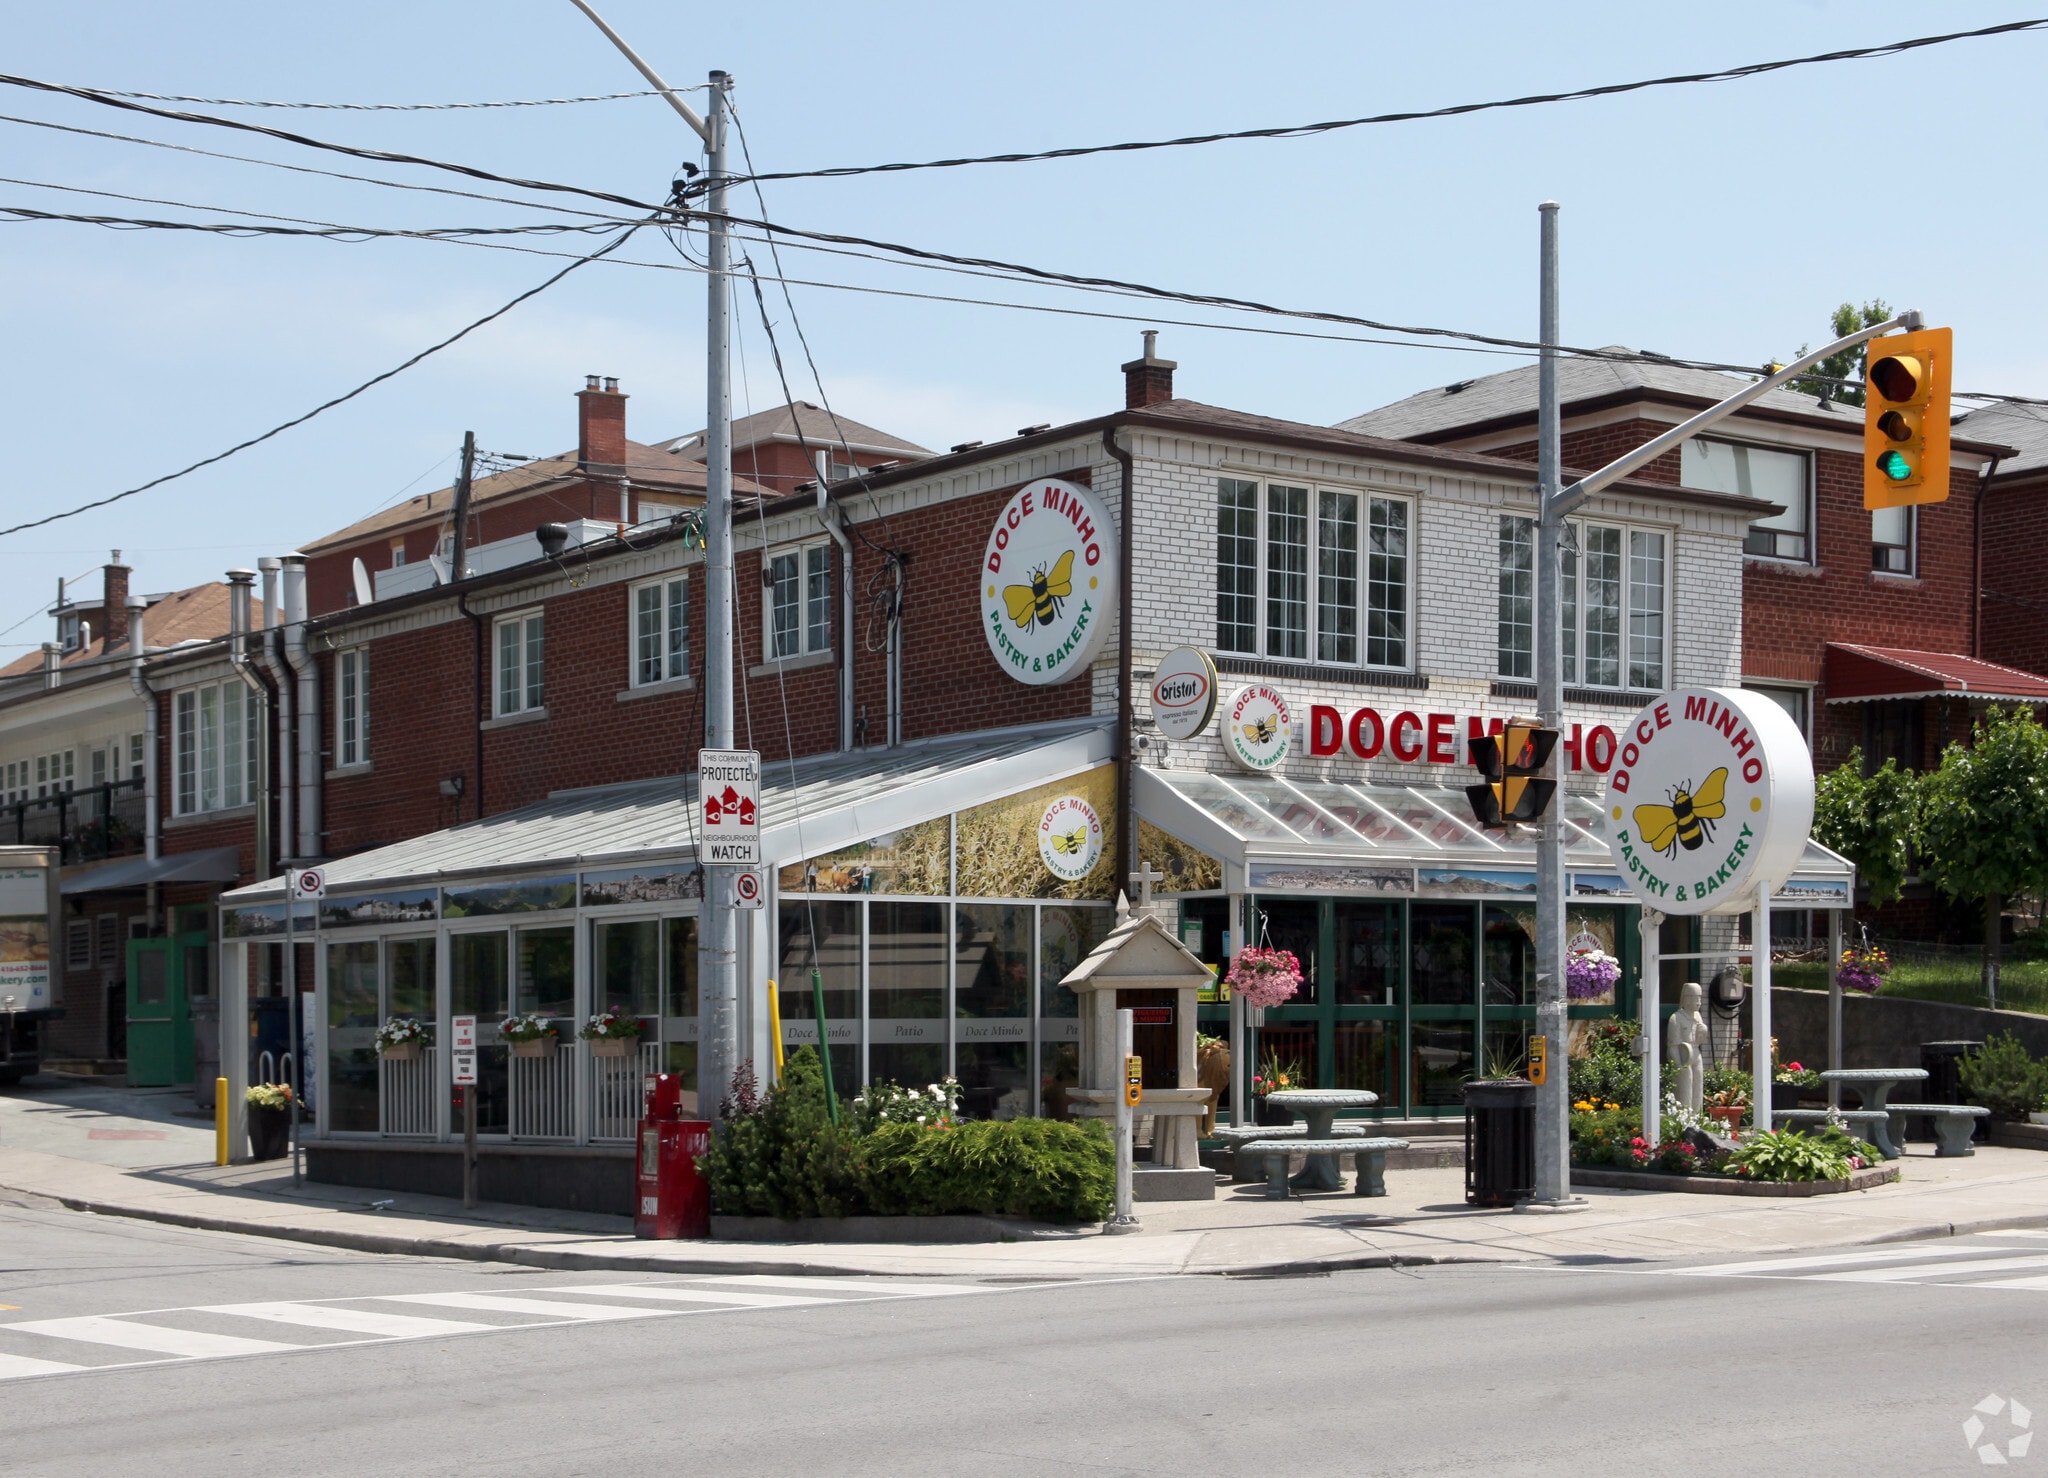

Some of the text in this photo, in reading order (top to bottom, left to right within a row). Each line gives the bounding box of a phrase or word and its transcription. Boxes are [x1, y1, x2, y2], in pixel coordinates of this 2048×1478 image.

[987, 486, 1100, 574] DOCE MINHO
[990, 598, 1093, 672] PASTRY & BAKERY
[1161, 680, 1196, 700] bristot
[1233, 687, 1289, 724] DOCE MINHO
[1310, 704, 1617, 774] DOCE MHO
[1612, 695, 1763, 794] DOCE MINHO
[703, 754, 717, 762] THIS
[1234, 737, 1257, 764] PASTRY
[1264, 740, 1287, 766] BAKERY
[1042, 799, 1100, 834] DOCE MINHO
[703, 834, 757, 842] NEIGHBOURHOOD
[711, 845, 751, 860] WATCH
[1043, 850, 1067, 876] PASTRY
[1075, 850, 1098, 876] BAKERY
[1617, 822, 1754, 902] PASTRY & BAKERY
[1053, 911, 1076, 943] MINHO
[1584, 934, 1602, 950] MINH
[0, 975, 48, 986] kery.com
[788, 1024, 851, 1038] Doce inho
[895, 1026, 924, 1038] Patio
[965, 1024, 1024, 1037] Doce Minho
[643, 1196, 658, 1216] SUN
